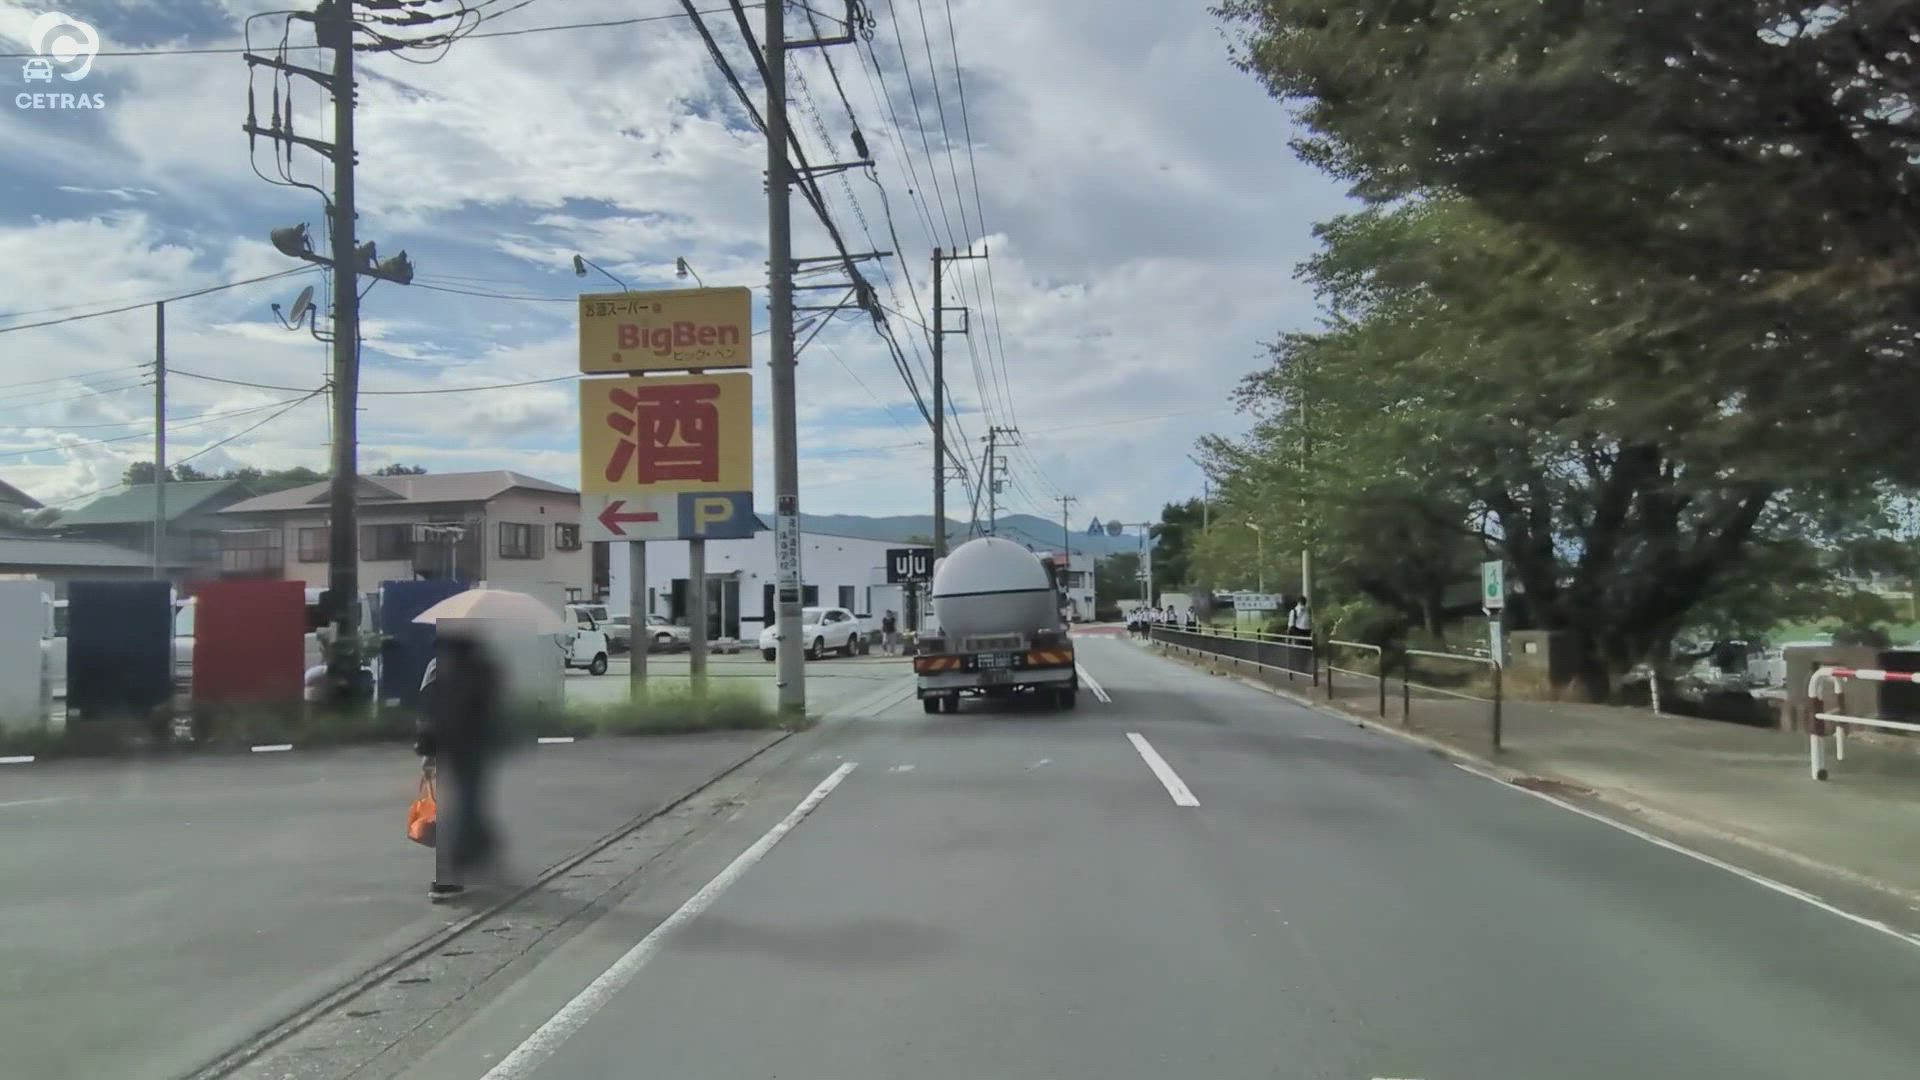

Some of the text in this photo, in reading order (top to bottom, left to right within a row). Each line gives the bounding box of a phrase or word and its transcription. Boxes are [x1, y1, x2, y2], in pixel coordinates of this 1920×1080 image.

[617, 321, 739, 356] BigBen
[605, 383, 721, 484] 酒
[693, 497, 733, 535] P
[896, 549, 926, 578] uju
